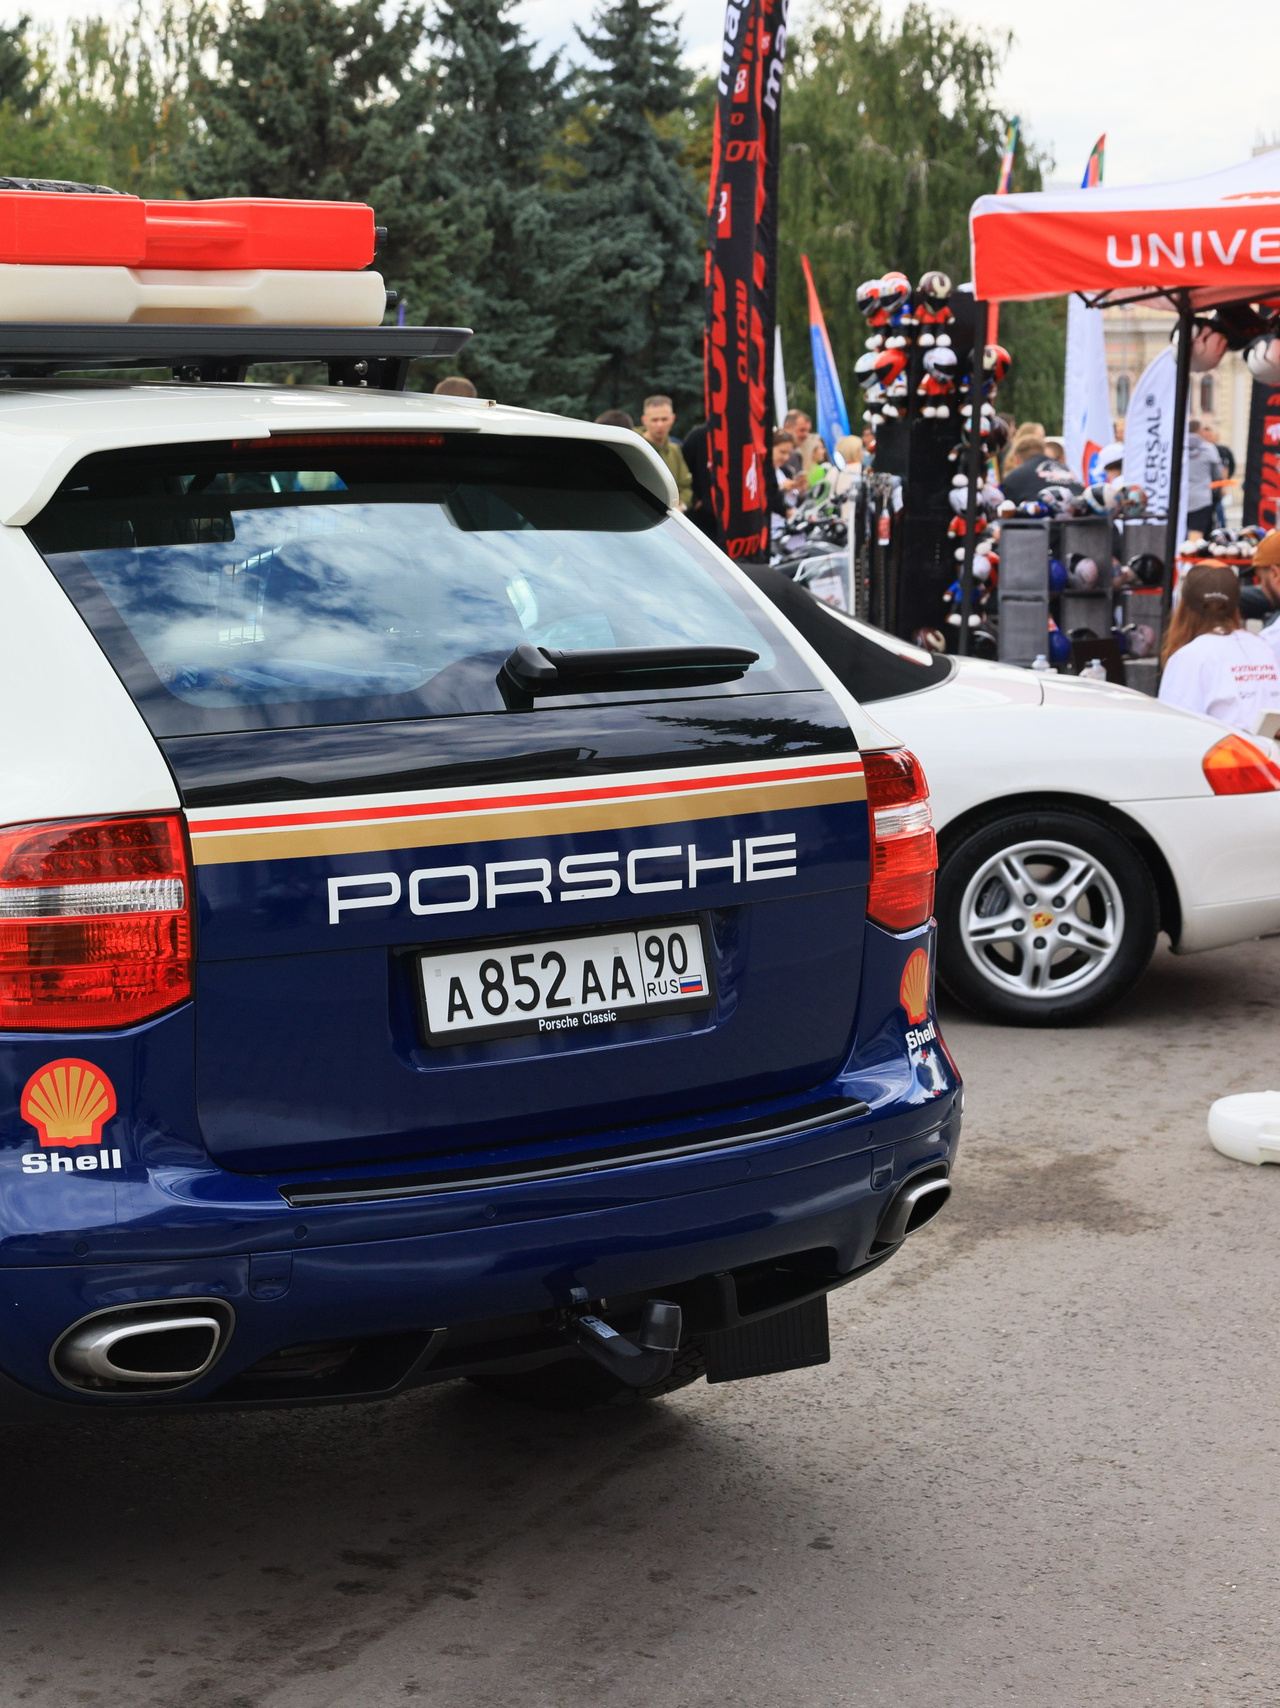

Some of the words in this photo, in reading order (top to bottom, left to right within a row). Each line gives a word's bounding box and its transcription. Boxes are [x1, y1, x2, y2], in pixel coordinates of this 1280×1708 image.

[327, 832, 798, 926] PORSCHE
[644, 932, 688, 979] 90
[646, 979, 679, 998] RUS
[538, 1014, 579, 1032] Porsche
[582, 1009, 618, 1026] Classic
[905, 1021, 937, 1050] Shell
[22, 1148, 123, 1175] Shell
